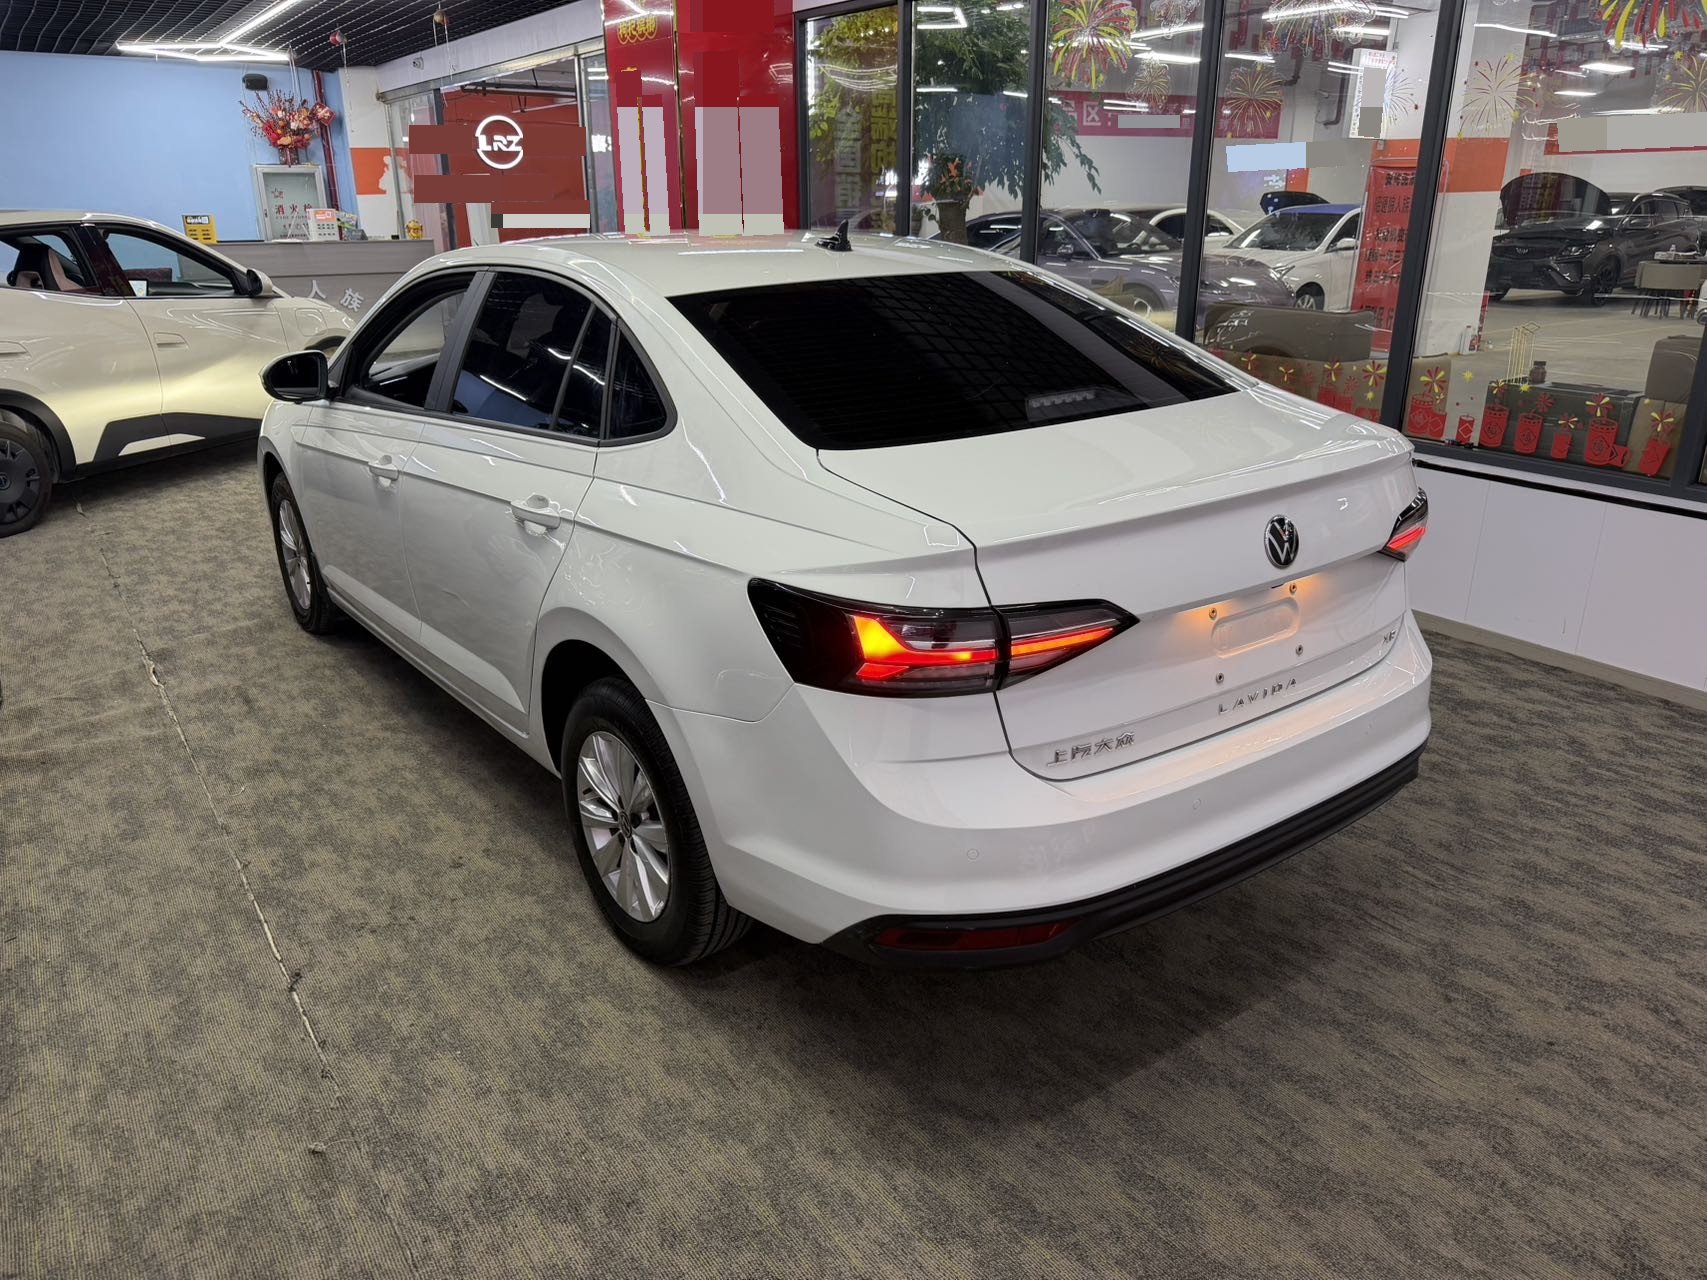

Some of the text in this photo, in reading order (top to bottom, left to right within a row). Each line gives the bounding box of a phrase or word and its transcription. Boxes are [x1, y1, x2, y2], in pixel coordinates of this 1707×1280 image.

[1218, 677, 1297, 715] LAVIDA
[1047, 730, 1135, 767] 上汽大众
